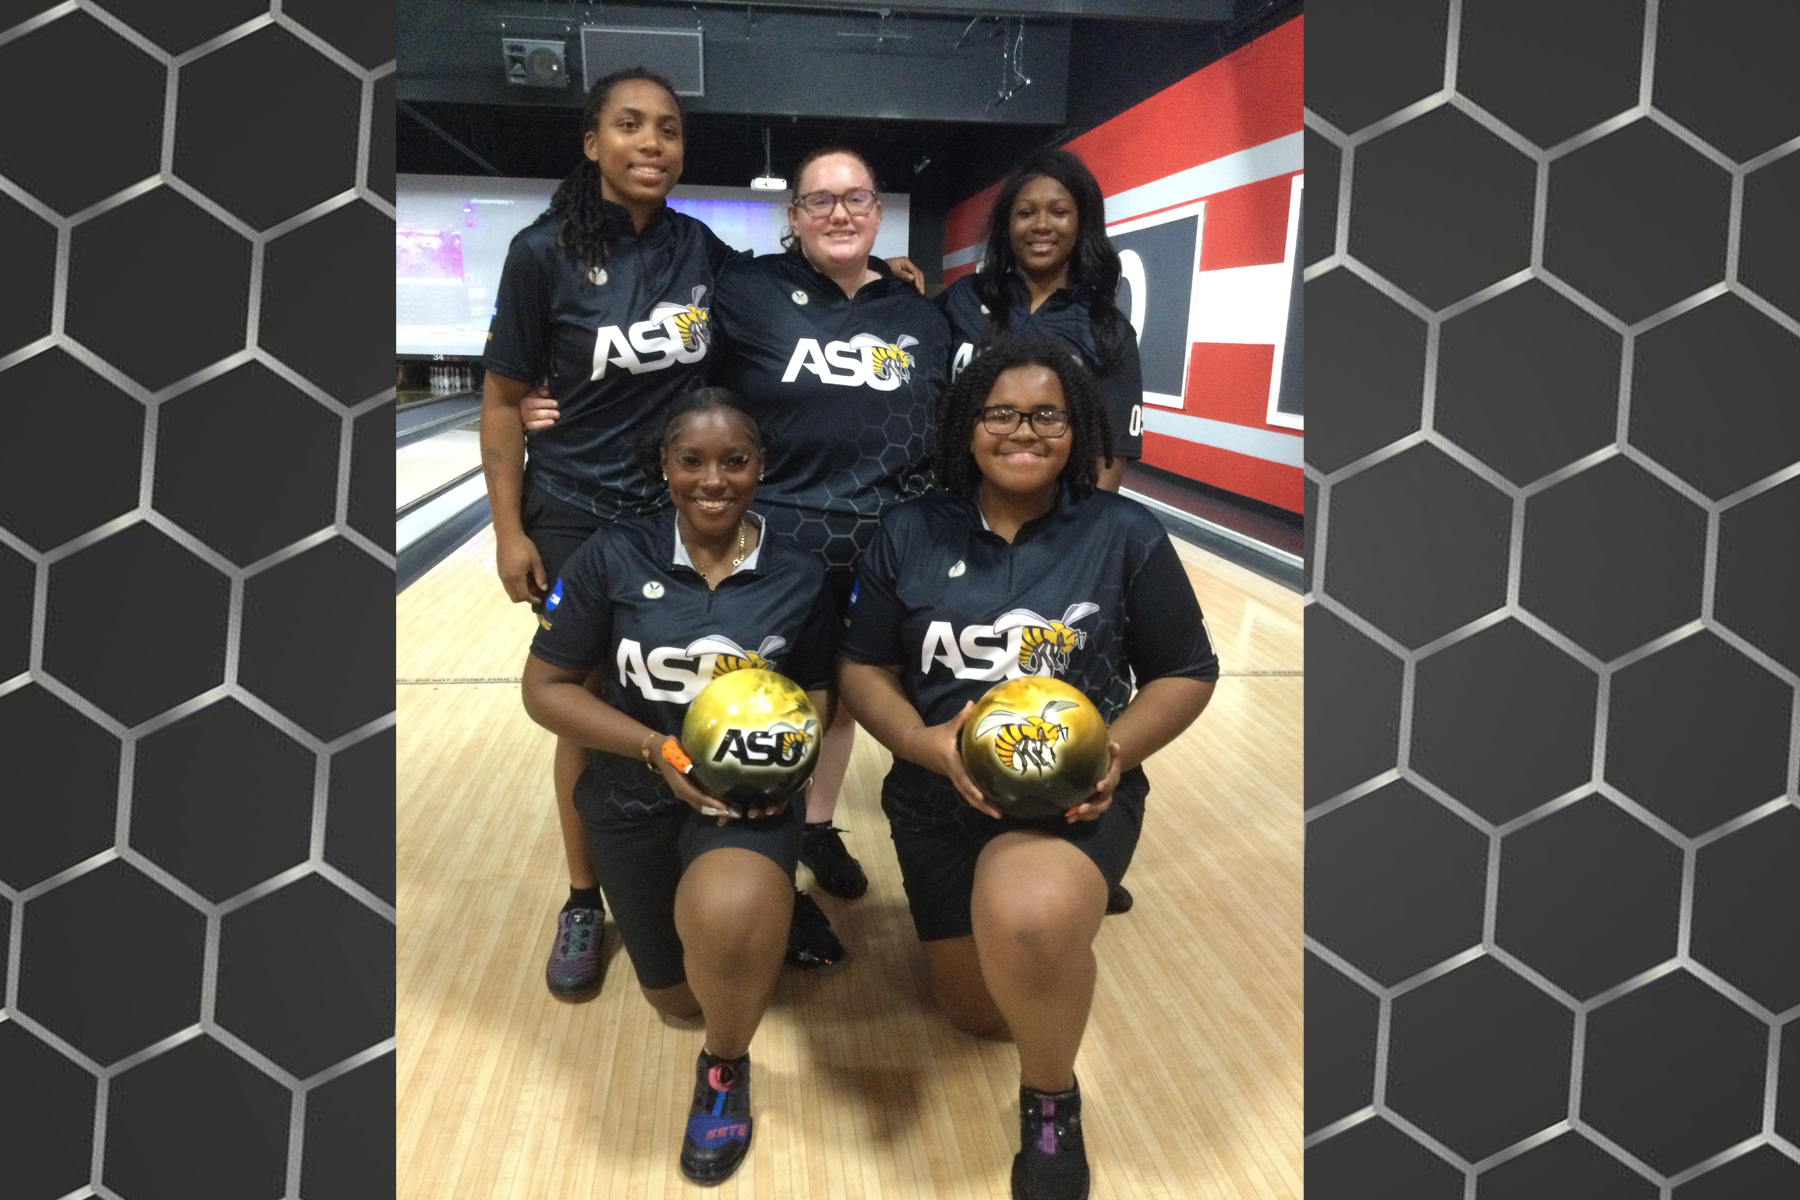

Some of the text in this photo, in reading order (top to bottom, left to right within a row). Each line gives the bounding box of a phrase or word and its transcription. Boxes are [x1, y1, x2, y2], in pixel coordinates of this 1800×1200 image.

[591, 312, 707, 381] ASU
[781, 337, 903, 391] ASU
[712, 729, 803, 767] ASU
